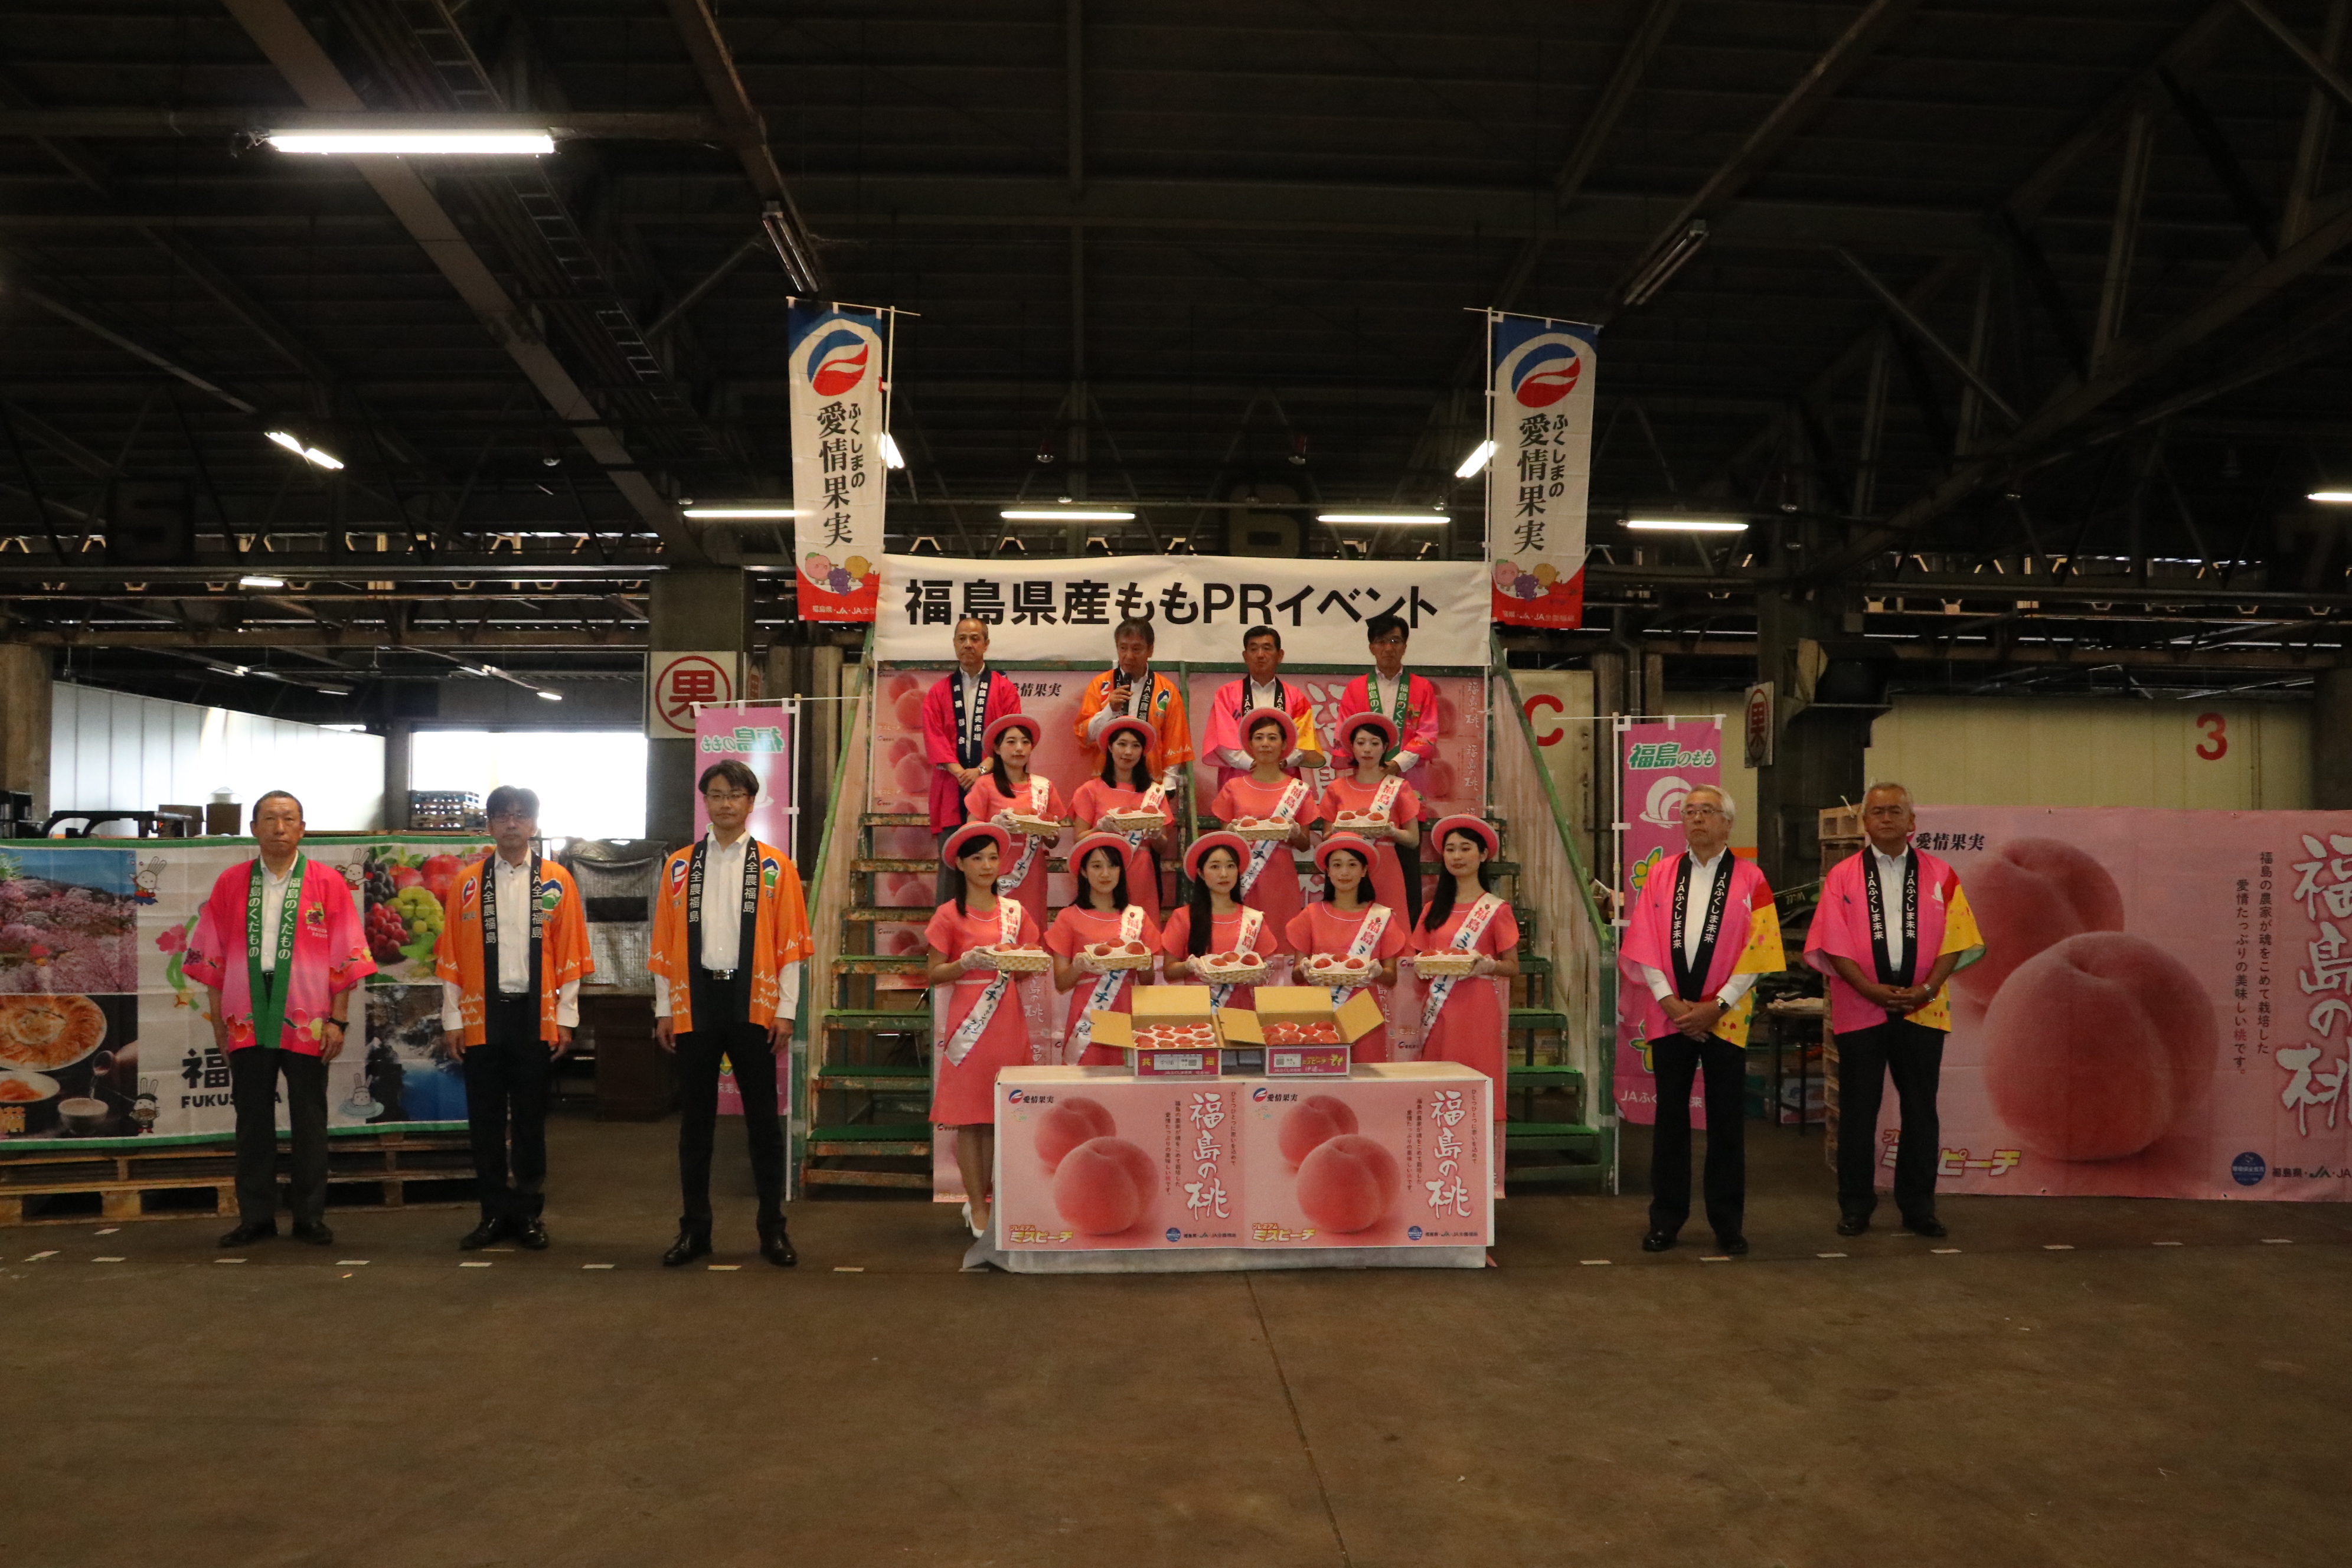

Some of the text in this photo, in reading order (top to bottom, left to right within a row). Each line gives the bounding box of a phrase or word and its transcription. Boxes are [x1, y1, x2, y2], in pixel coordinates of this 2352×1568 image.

[817, 401, 852, 548] 愛情果実
[849, 403, 865, 488] ふくしまの
[1549, 414, 1569, 498] ふくしまの
[1514, 413, 1551, 555] 愛情果実
[905, 579, 1438, 628] 福島県産ももPRイベント
[668, 670, 717, 718] 果
[1523, 694, 1564, 746] C
[1627, 741, 1716, 770] 福島のもも
[2196, 713, 2227, 760] 3
[1916, 832, 1985, 851] 愛情果実
[249, 876, 262, 957] 福島のくだもの
[278, 878, 302, 959] 福島のくだもの
[483, 868, 497, 944] JA全農福島
[531, 865, 543, 939] JA全農福島
[688, 850, 704, 923] JA全農福島
[1466, 907, 1490, 933] 福島
[1672, 876, 1685, 949] JAふくしま未来
[1704, 872, 1726, 943] JAふくしま未来
[1868, 871, 1884, 940] JAふくしま未来
[1906, 870, 1916, 939] JAふくしま未来
[2233, 879, 2249, 1074] 愛情たっぷりの美味しい桃です。
[2257, 851, 2272, 1054] 福島の農家が魂をこめて栽培した
[181, 1048, 230, 1089] 福
[1023, 1095, 1054, 1103] 愛情果実
[1184, 1093, 1230, 1220] 福島の桃
[1425, 1090, 1472, 1219] 福島の桃
[1010, 1231, 1073, 1244] ミスピーチ
[1253, 1229, 1316, 1242] ミスピーチ
